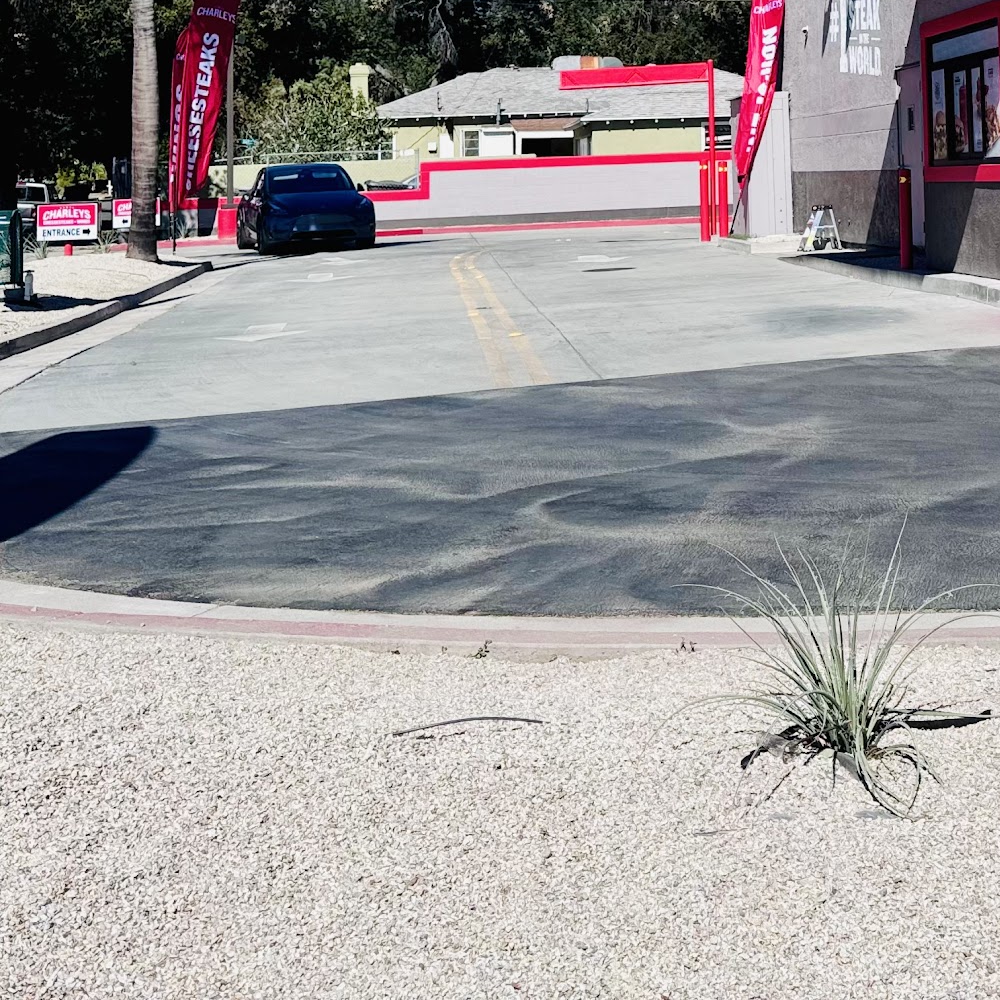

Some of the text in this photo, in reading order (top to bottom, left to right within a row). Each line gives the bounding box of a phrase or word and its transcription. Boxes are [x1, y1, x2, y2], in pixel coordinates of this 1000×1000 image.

[196, 6, 237, 25] CHARLEYS
[848, 0, 881, 31] STEAK
[42, 208, 92, 220] CHARLEYS
[42, 227, 81, 237] ENTRANCE
